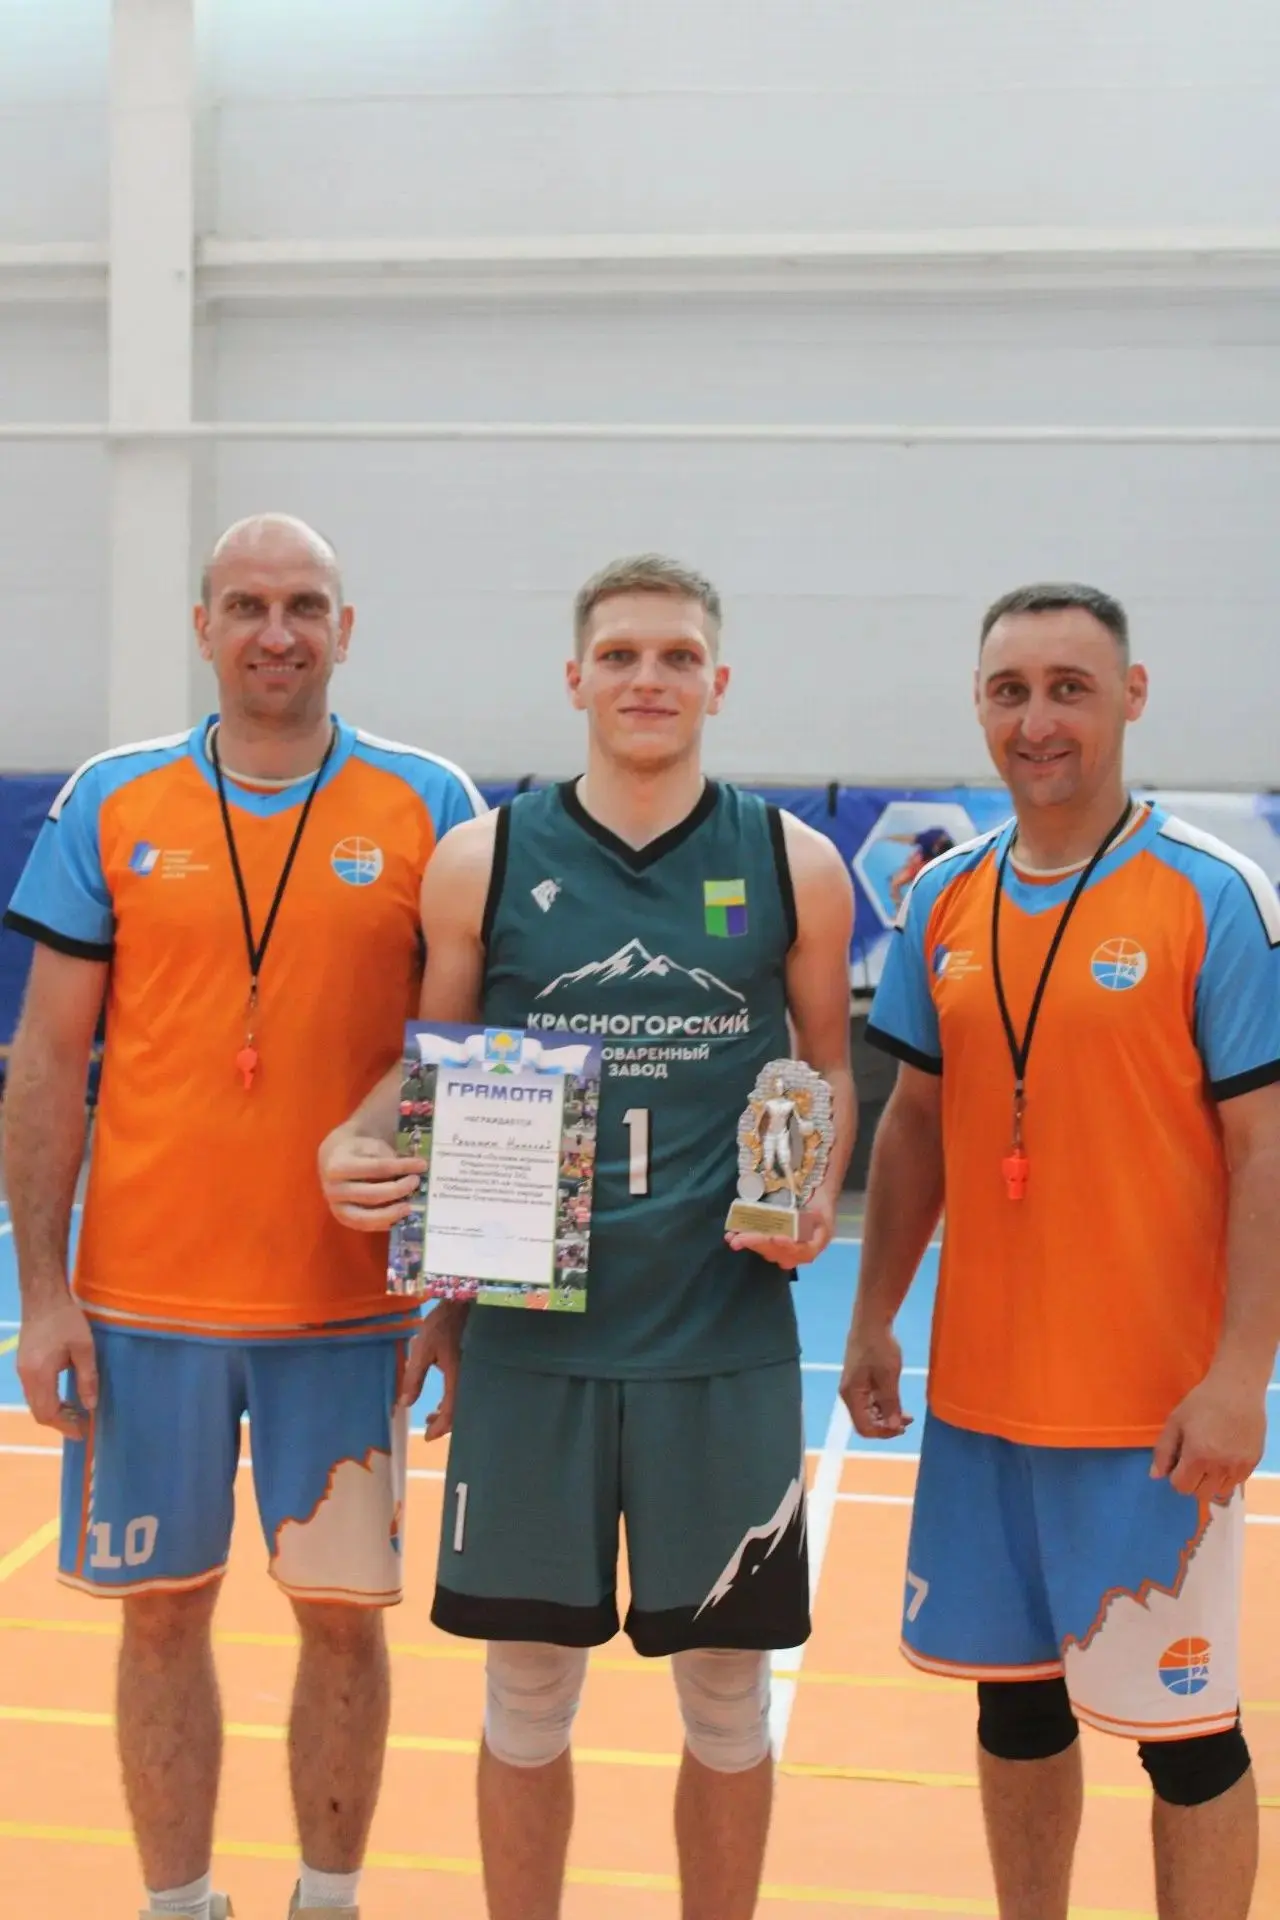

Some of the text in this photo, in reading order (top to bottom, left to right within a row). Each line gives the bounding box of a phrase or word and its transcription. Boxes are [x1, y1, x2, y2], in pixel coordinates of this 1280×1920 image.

[527, 1008, 750, 1036] КРАСНОГОРСКИЙ
[601, 1043, 710, 1061] ОВАРЕННЫЙ
[608, 1063, 668, 1079] ЗАВОД
[447, 1081, 553, 1103] ГРАМОТА
[622, 1108, 650, 1195] 1
[453, 1482, 468, 1552] 1
[90, 1515, 158, 1568] 10
